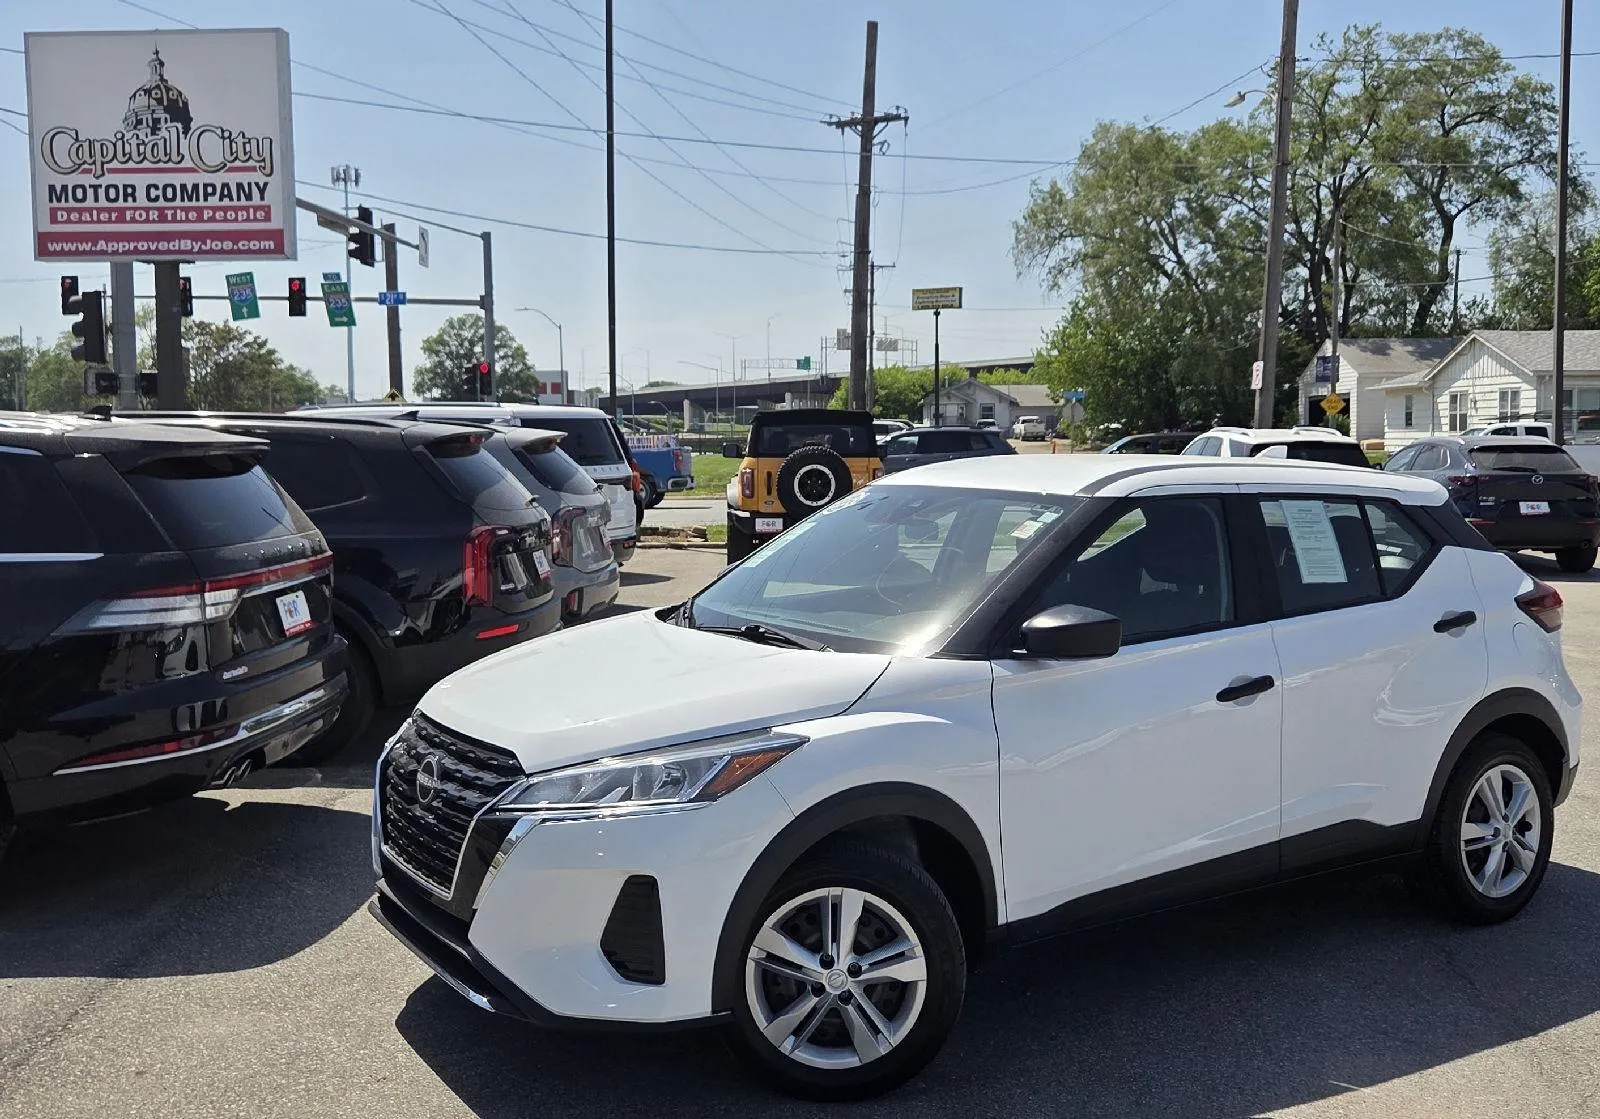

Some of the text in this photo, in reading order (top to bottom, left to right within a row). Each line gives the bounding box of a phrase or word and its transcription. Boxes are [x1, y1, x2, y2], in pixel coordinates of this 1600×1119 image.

[41, 125, 274, 178] Capital City
[48, 181, 269, 204] MOTOR COMPANY
[57, 209, 119, 222] Dealer
[125, 209, 160, 221] FOR
[164, 208, 198, 221] The
[47, 239, 275, 253] www.ApprovedByJoe.com
[328, 298, 349, 309] 235
